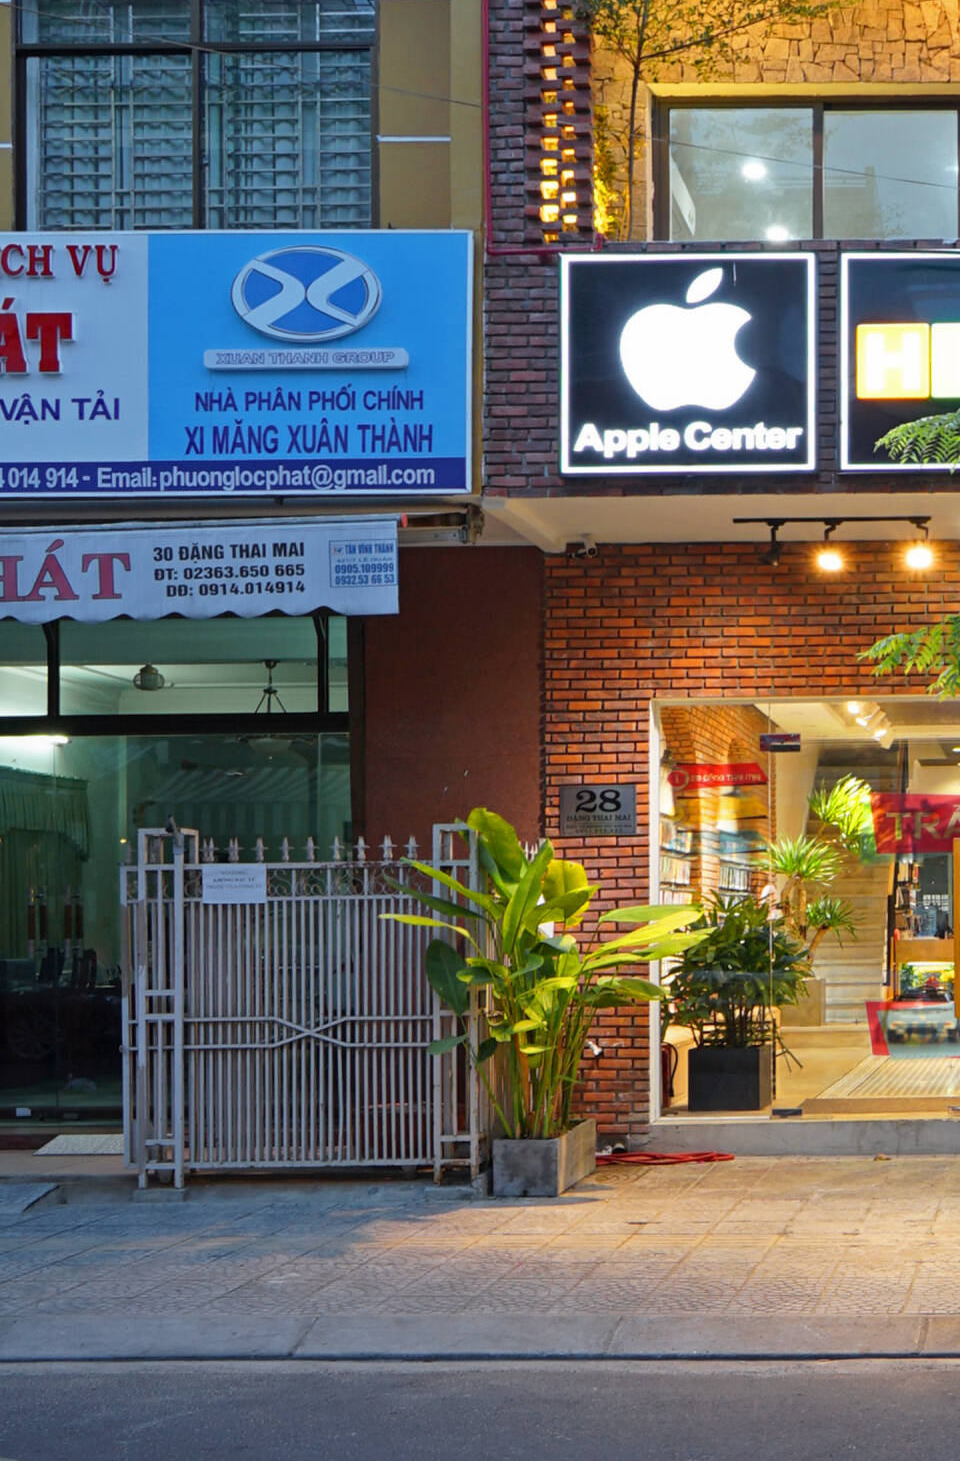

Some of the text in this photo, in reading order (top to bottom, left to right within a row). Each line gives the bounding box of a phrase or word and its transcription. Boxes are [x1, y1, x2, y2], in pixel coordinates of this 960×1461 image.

[0, 243, 119, 282] CH VỤ
[215, 350, 395, 365] XUAN THANH GROUP
[0, 389, 120, 425] VẬN TẢI
[194, 383, 424, 412] NHÀ PHÂN PHỐI CHÍNH
[184, 416, 433, 456] XI MĂNG XUÂN THÀNH
[573, 420, 803, 458] Apple Center
[8, 467, 41, 489] 014
[45, 467, 79, 489] 914
[152, 541, 305, 564] 30 ĐẶNG THAI MAI
[153, 563, 305, 581] ĐT: 02363.650 665
[166, 580, 306, 598] DĐ: 0914.014914
[575, 788, 622, 813] 28
